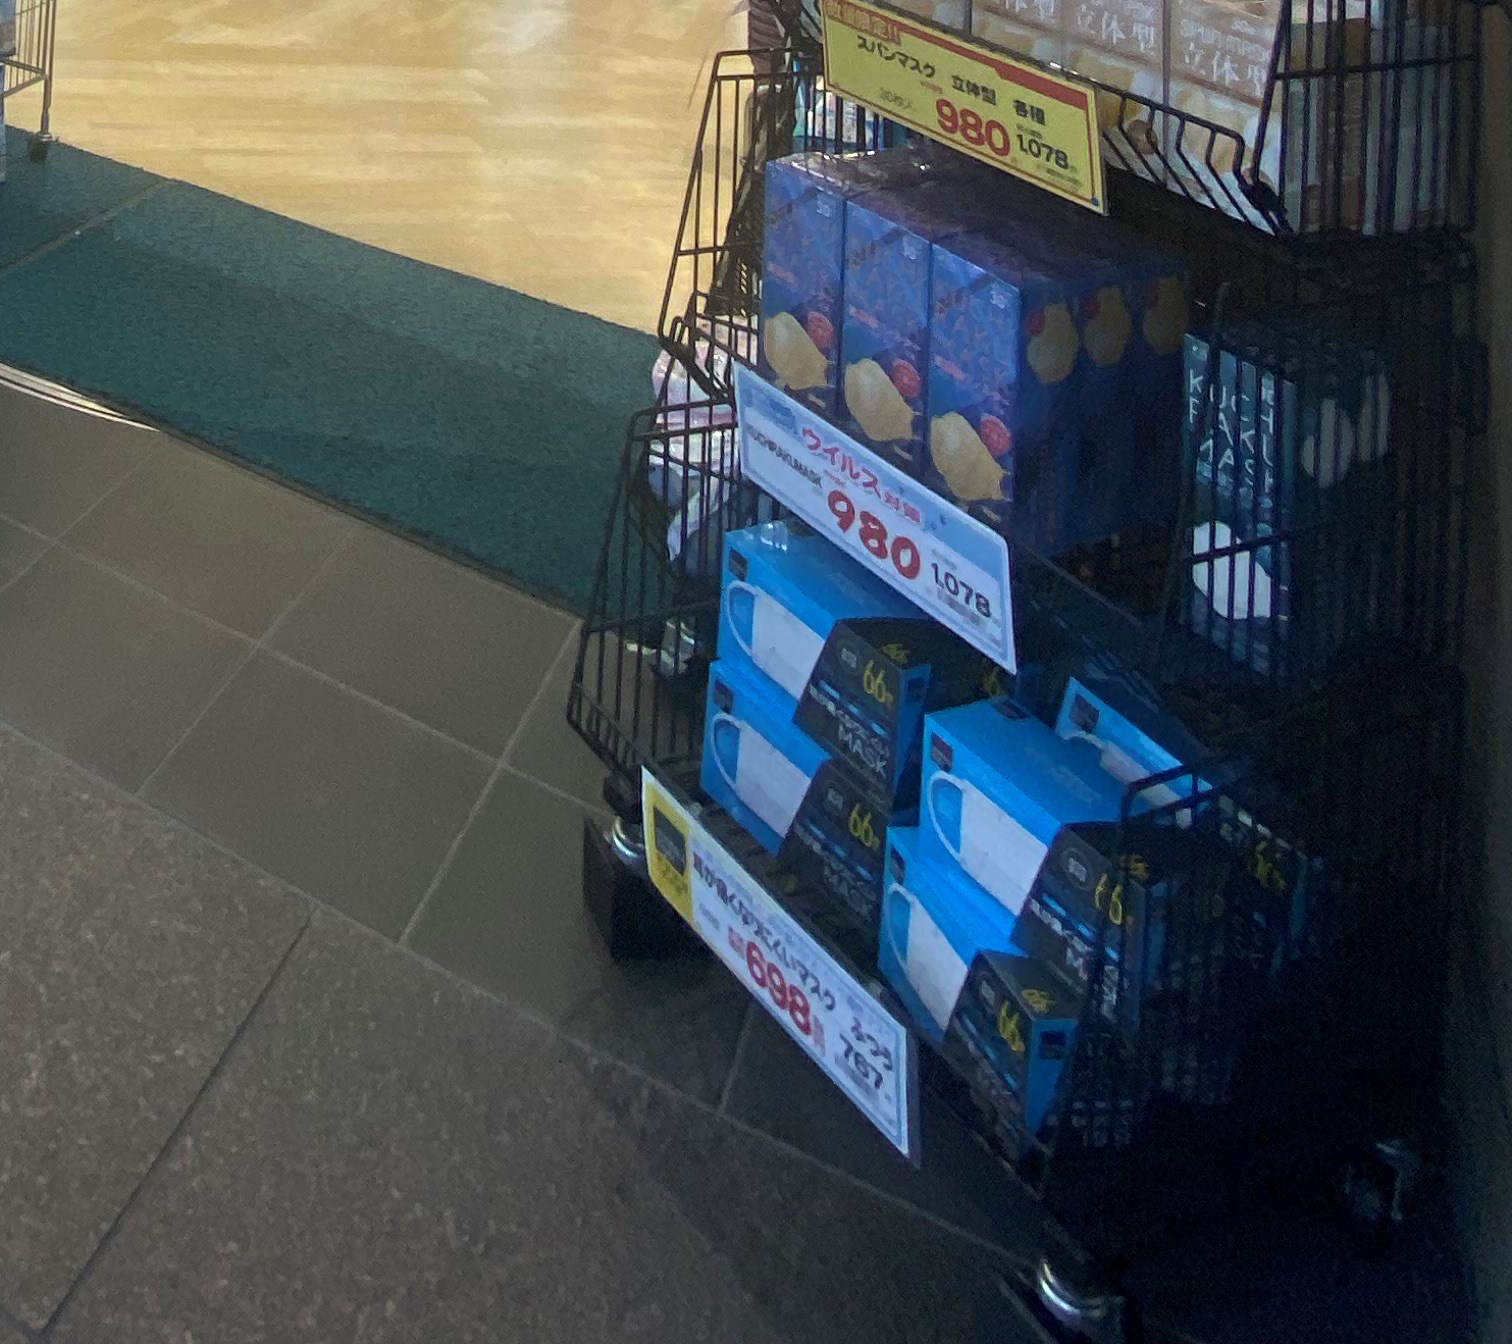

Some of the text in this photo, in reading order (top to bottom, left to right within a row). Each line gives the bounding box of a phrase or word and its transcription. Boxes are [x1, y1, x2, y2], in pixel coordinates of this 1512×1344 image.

[856, 34, 936, 79] スパンマスク
[935, 98, 1011, 157] 980
[827, 489, 921, 581] 980
[837, 723, 888, 780] MASK
[745, 941, 812, 1037] 698
[840, 1033, 884, 1091] 767
